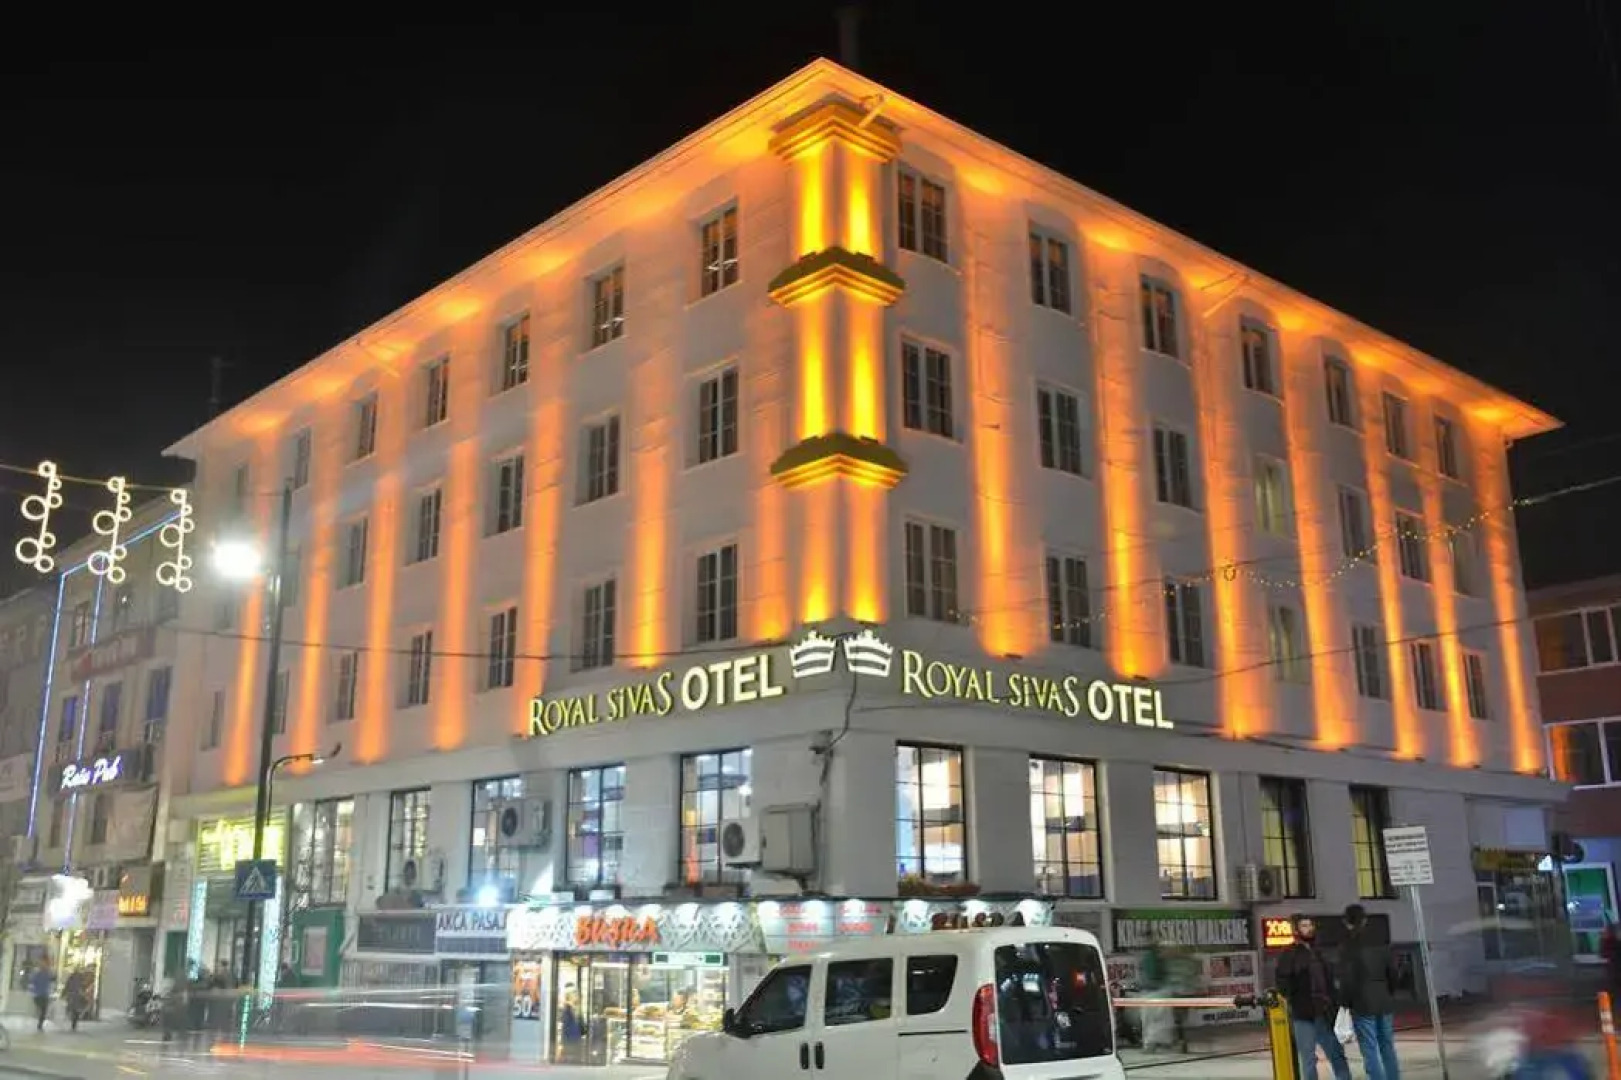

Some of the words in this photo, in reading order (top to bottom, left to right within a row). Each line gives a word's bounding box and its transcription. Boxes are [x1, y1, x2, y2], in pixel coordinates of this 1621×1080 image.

[528, 694, 599, 736] ROYAL
[681, 654, 784, 711] OTEL
[903, 649, 1000, 704] ROYAL
[1087, 680, 1174, 730] OTEL
